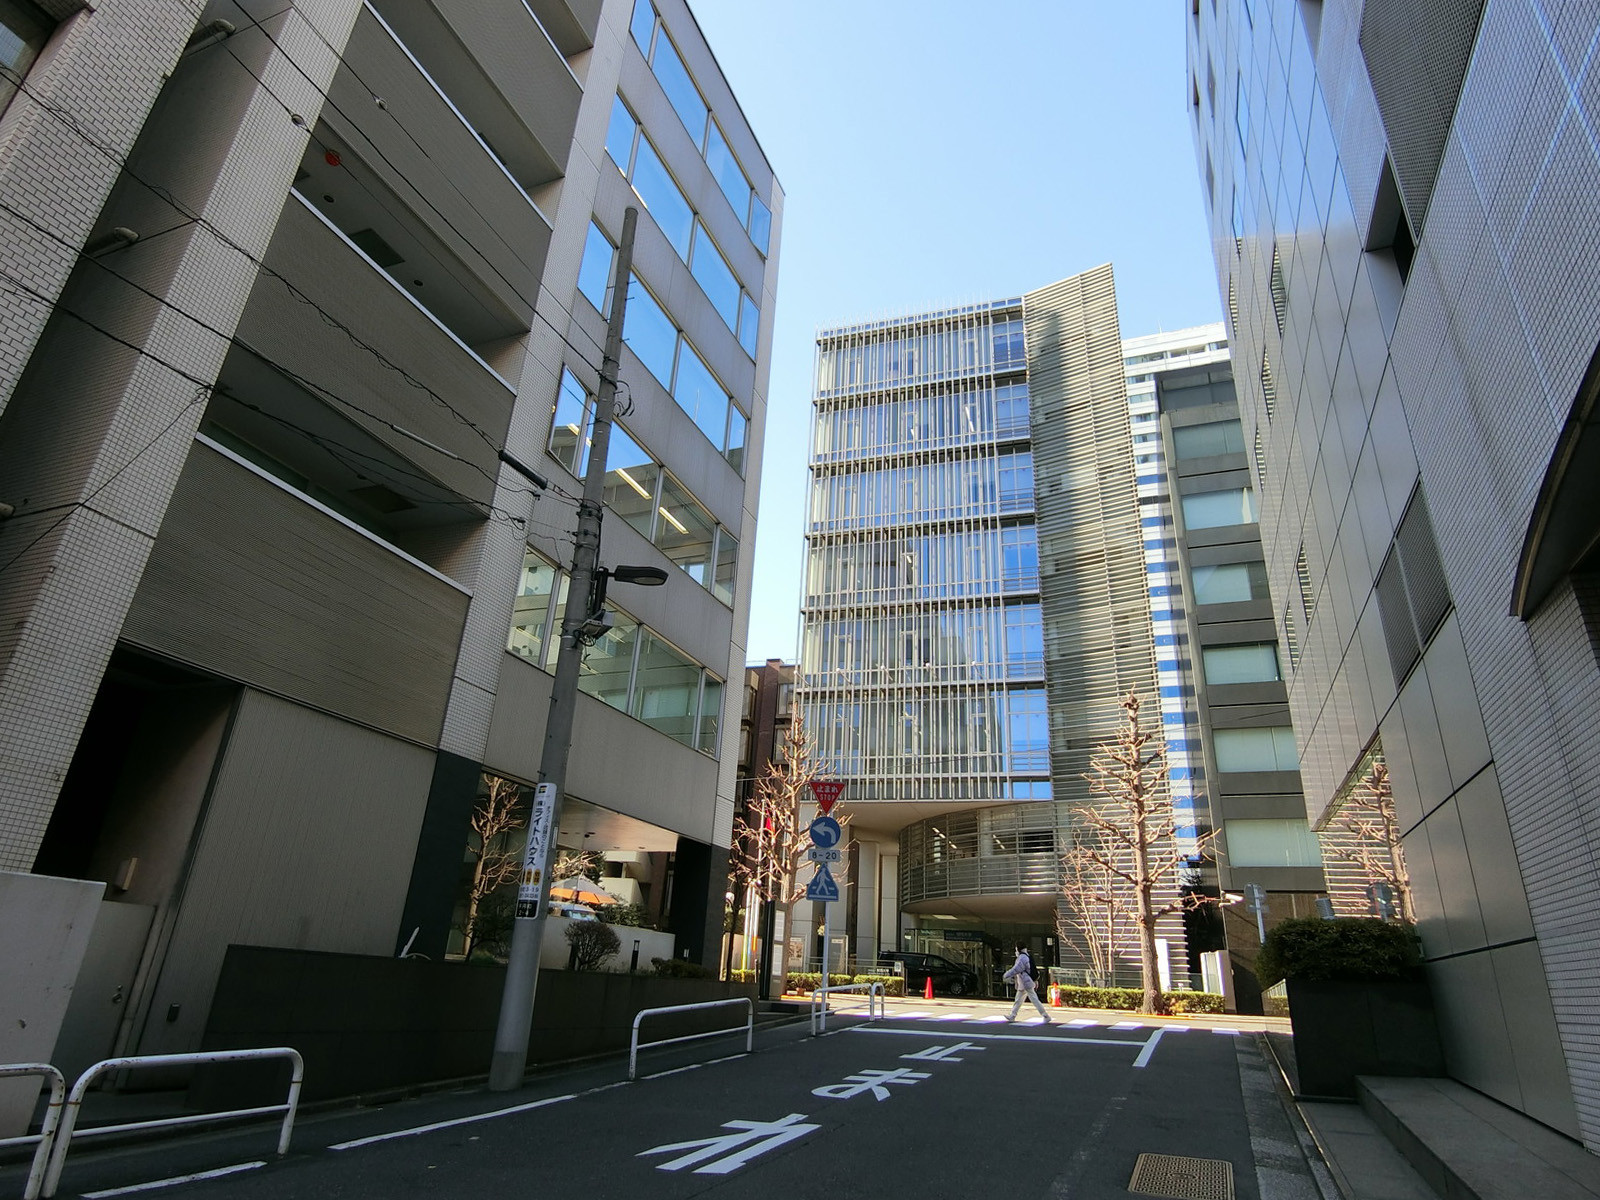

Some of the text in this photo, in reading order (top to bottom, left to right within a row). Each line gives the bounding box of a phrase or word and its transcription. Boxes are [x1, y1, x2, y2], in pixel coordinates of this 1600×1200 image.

[819, 793, 836, 801] STOP
[812, 851, 837, 860] 8-20
[634, 1041, 988, 1175] 止まれ
